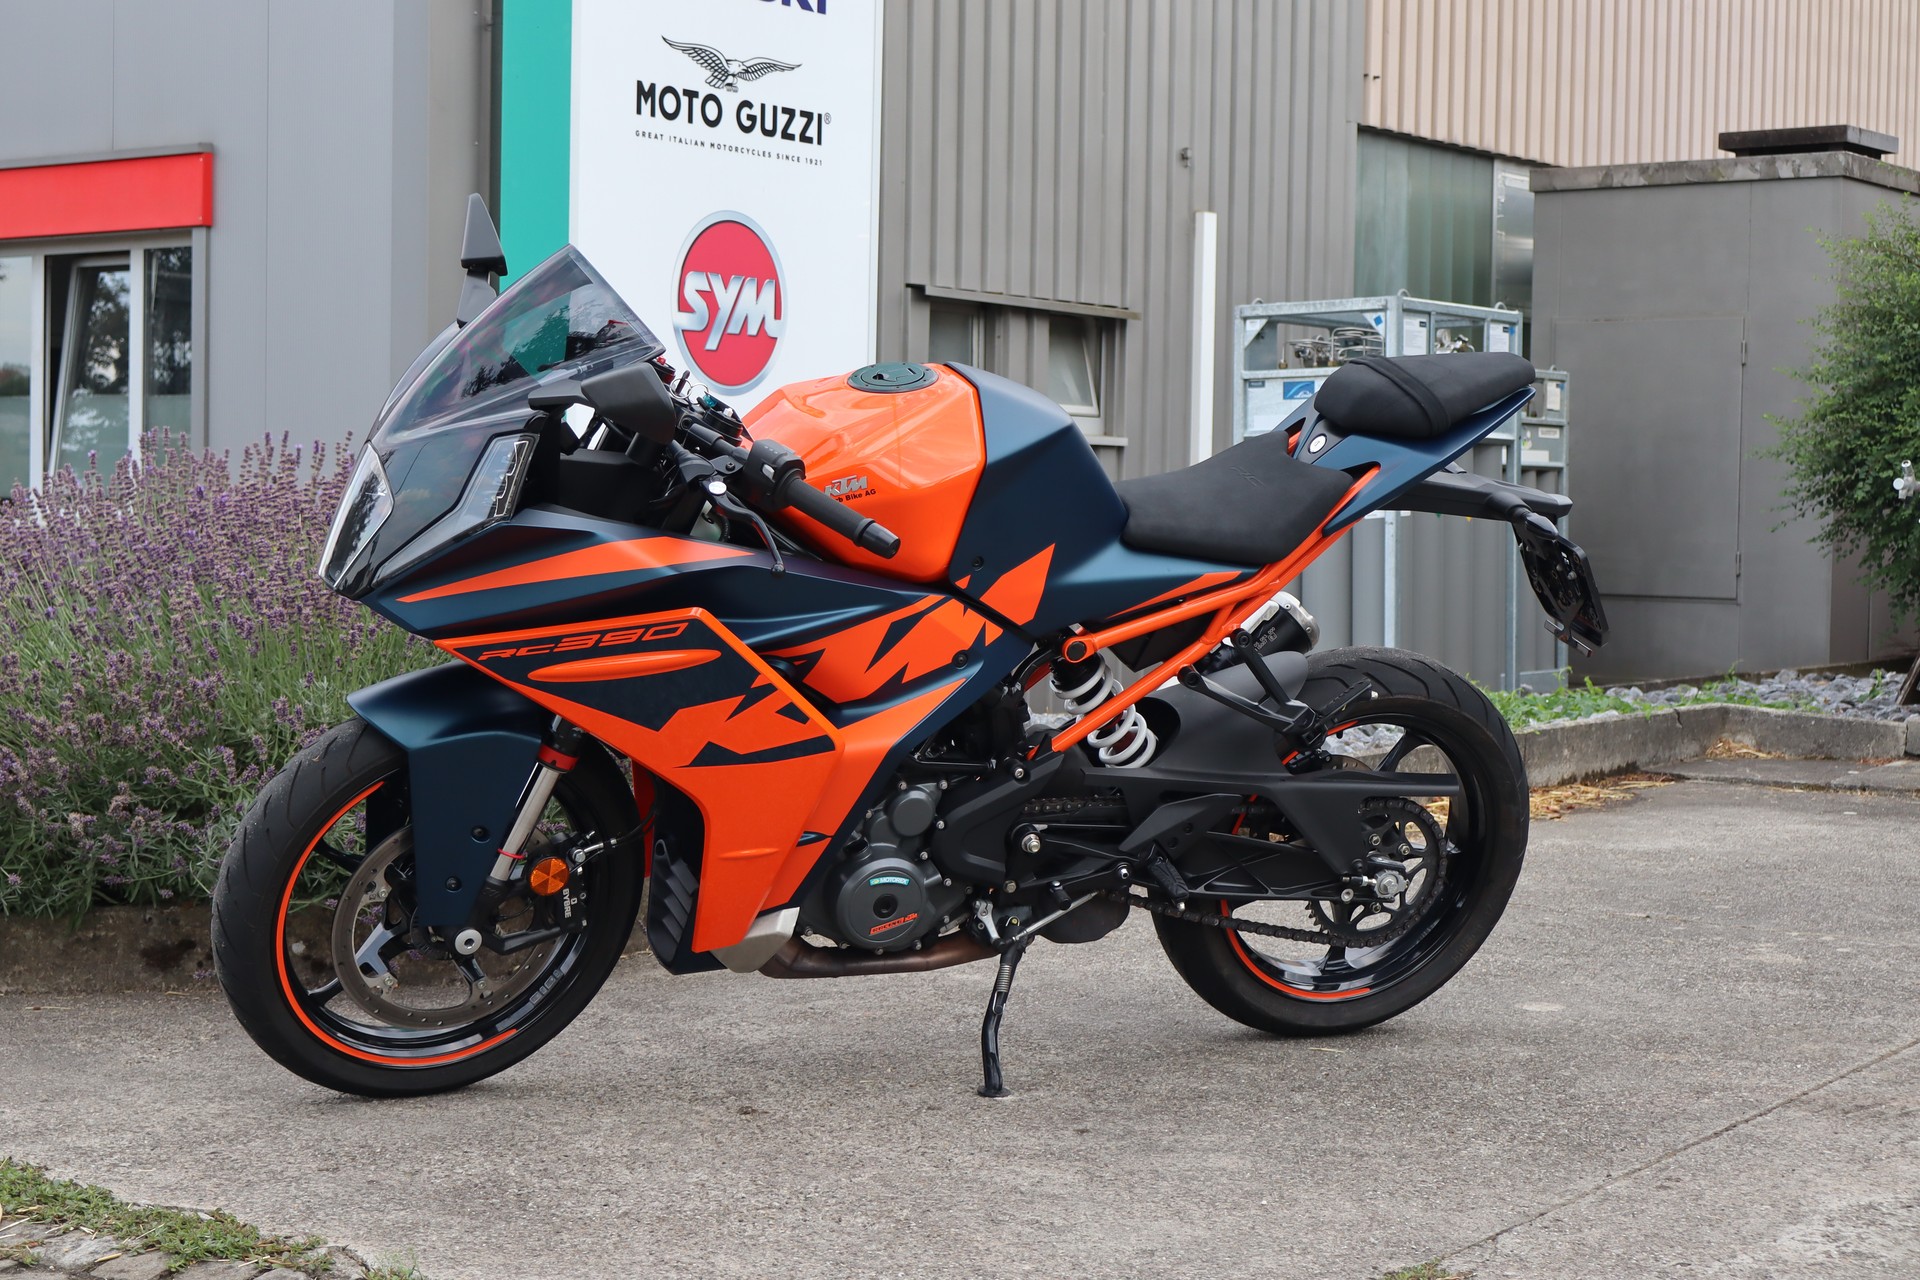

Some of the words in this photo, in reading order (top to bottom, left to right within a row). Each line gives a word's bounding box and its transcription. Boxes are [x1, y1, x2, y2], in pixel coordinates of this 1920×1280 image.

[635, 80, 724, 128] MOTO
[635, 129, 664, 141] GREAT
[669, 135, 705, 148] ITALIAN
[709, 142, 772, 159] MOTORCYCLES
[776, 153, 801, 163] SINCE
[805, 157, 823, 167] 1921
[675, 270, 784, 351] SYM
[824, 474, 868, 497] KTM
[845, 493, 863, 501] Bike
[865, 488, 877, 497] AG
[562, 888, 571, 918] BYBRE
